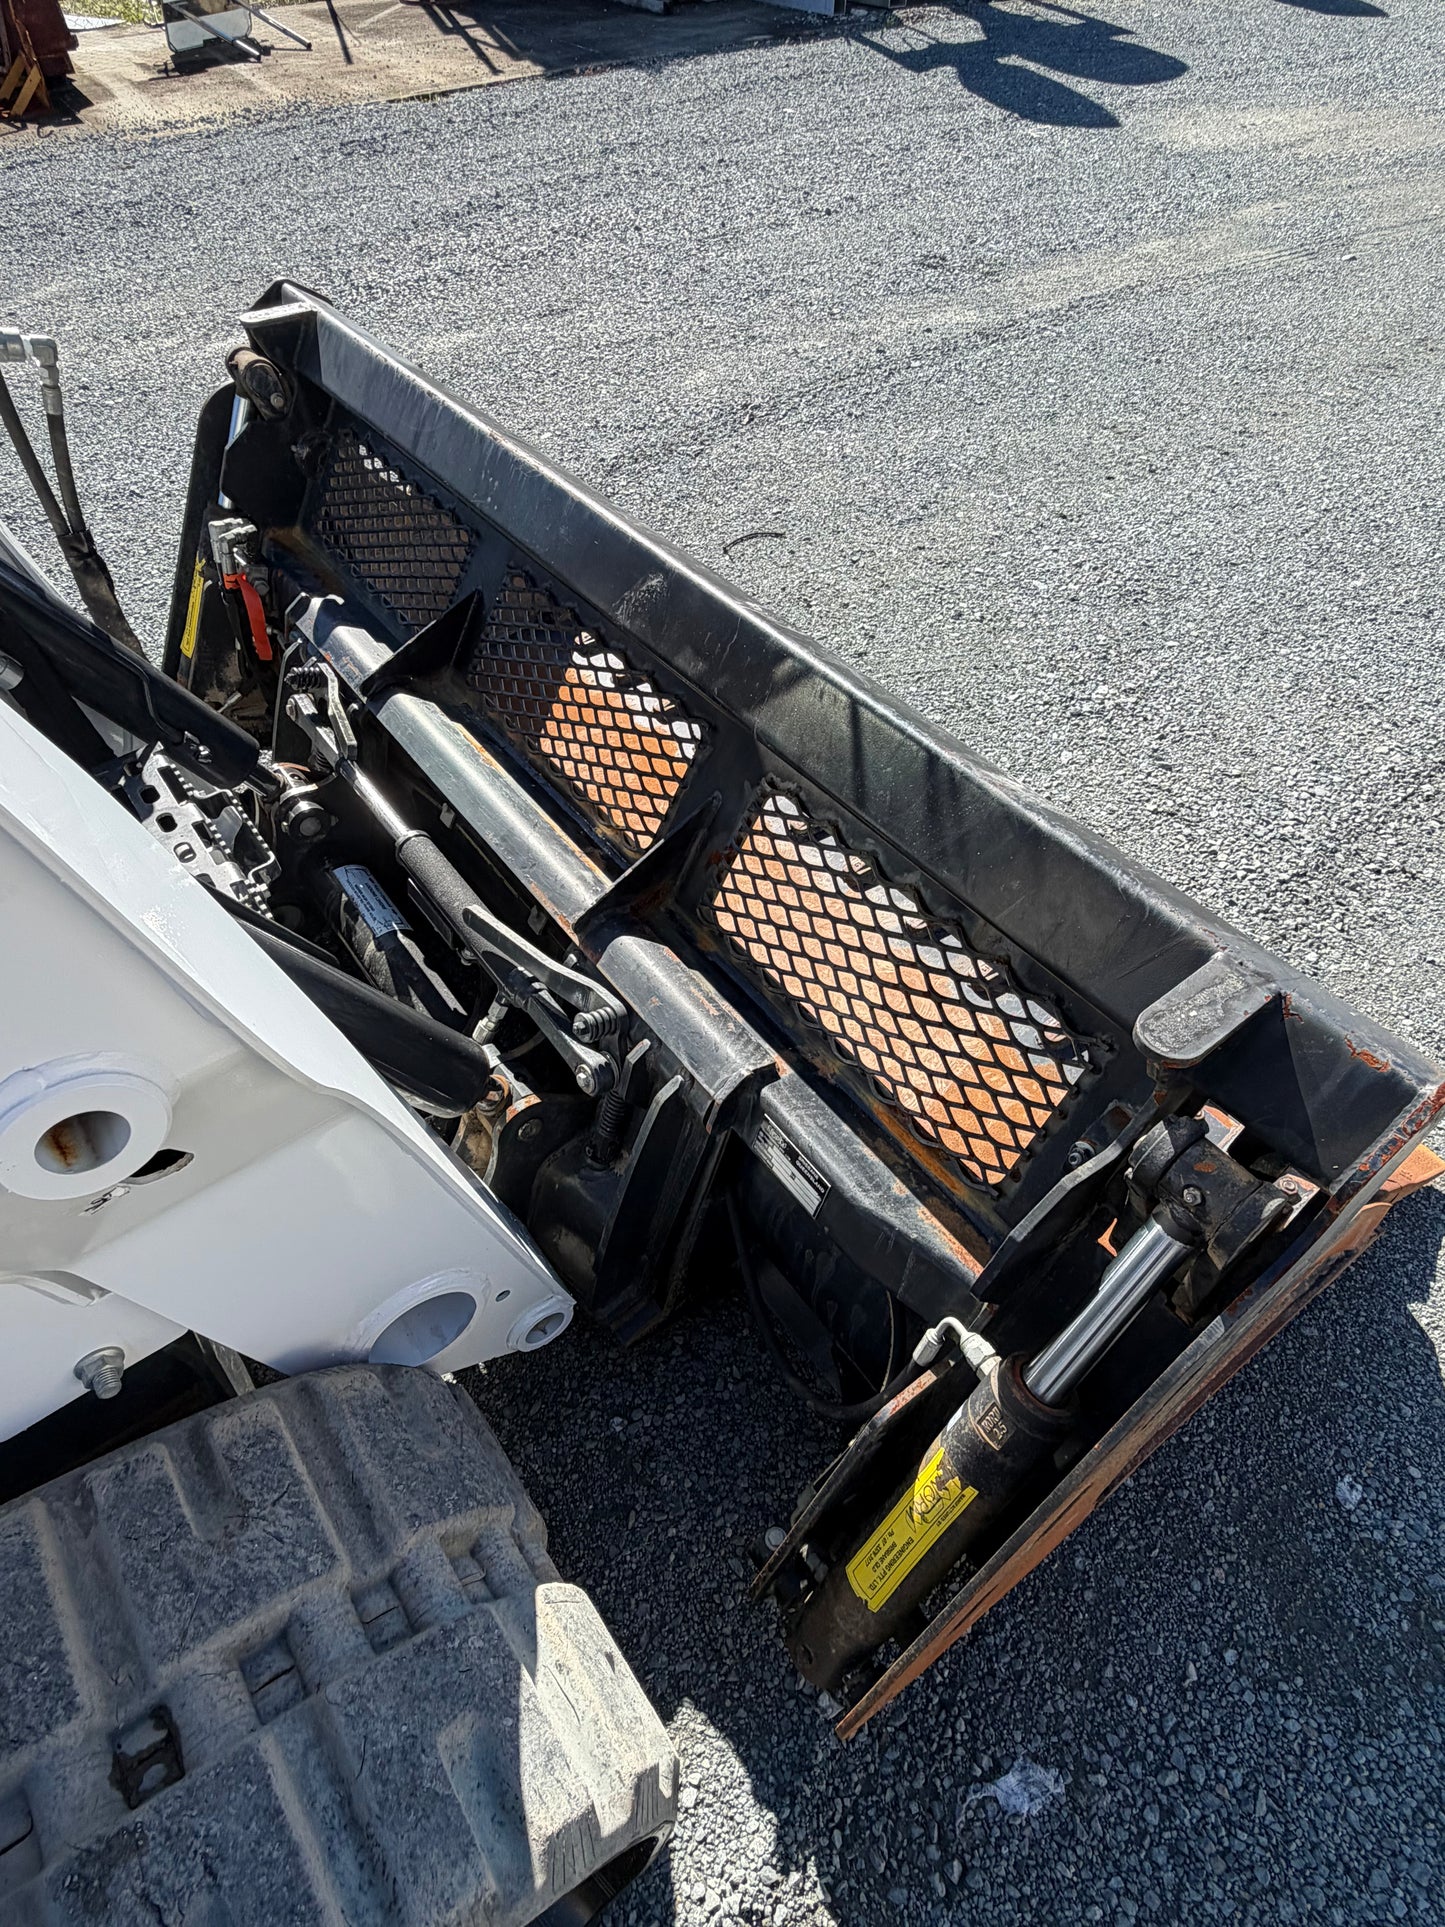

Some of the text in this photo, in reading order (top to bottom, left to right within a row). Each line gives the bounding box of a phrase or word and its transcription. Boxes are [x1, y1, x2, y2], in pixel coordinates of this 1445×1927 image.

[794, 1159, 826, 1194] QUEENSLAND
[869, 1540, 898, 1573] BRISBANE QLD
[883, 1535, 915, 1572] ENGINEERING
